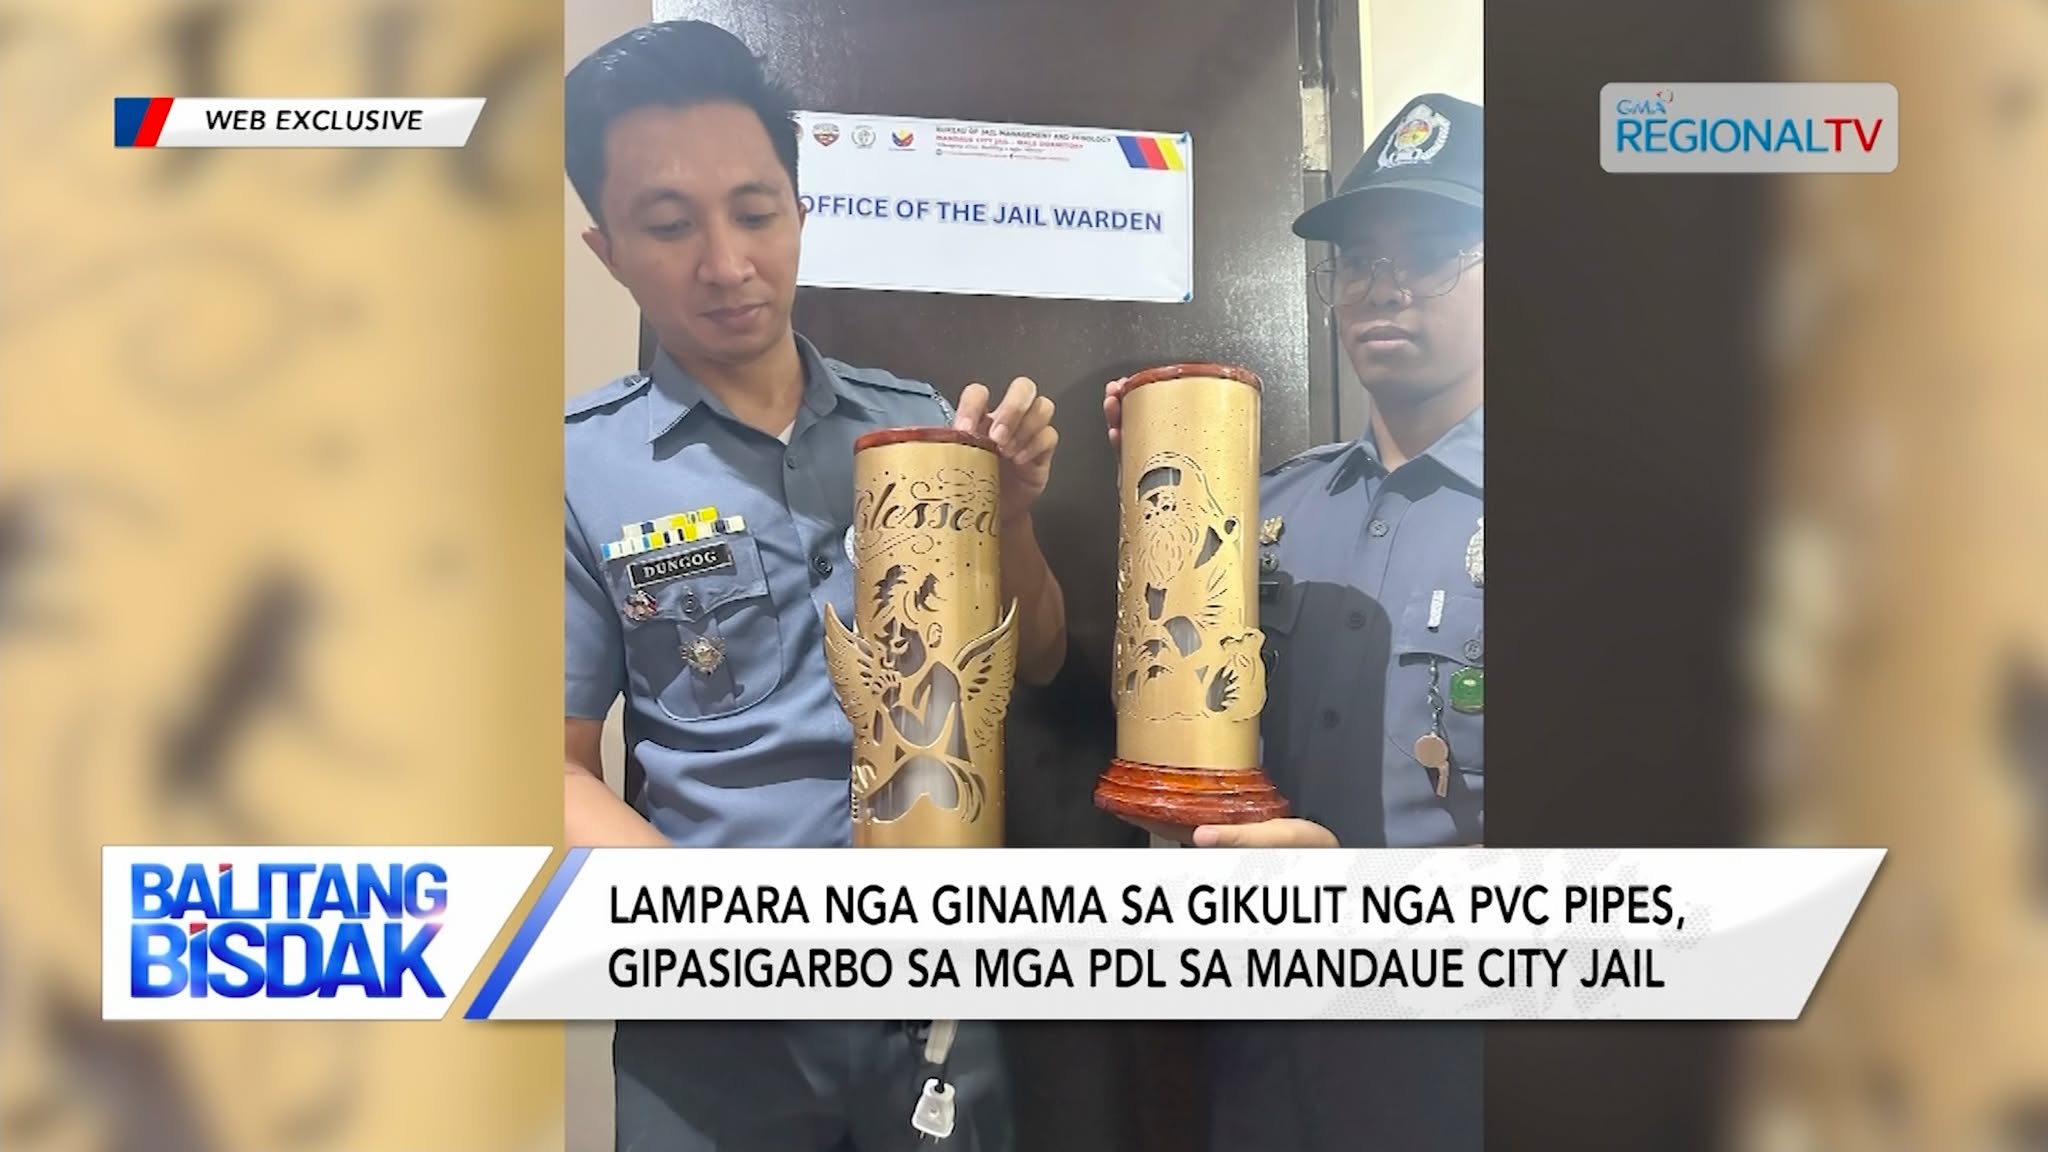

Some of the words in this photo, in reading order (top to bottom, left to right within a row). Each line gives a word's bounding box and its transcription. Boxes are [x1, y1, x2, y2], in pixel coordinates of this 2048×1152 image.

[799, 195, 889, 217] OFFICE
[896, 198, 930, 219] OF
[935, 201, 987, 223] THE
[993, 204, 1048, 226] JAIL
[1054, 207, 1163, 232] WARDEN
[642, 551, 718, 579] DUNGOG
